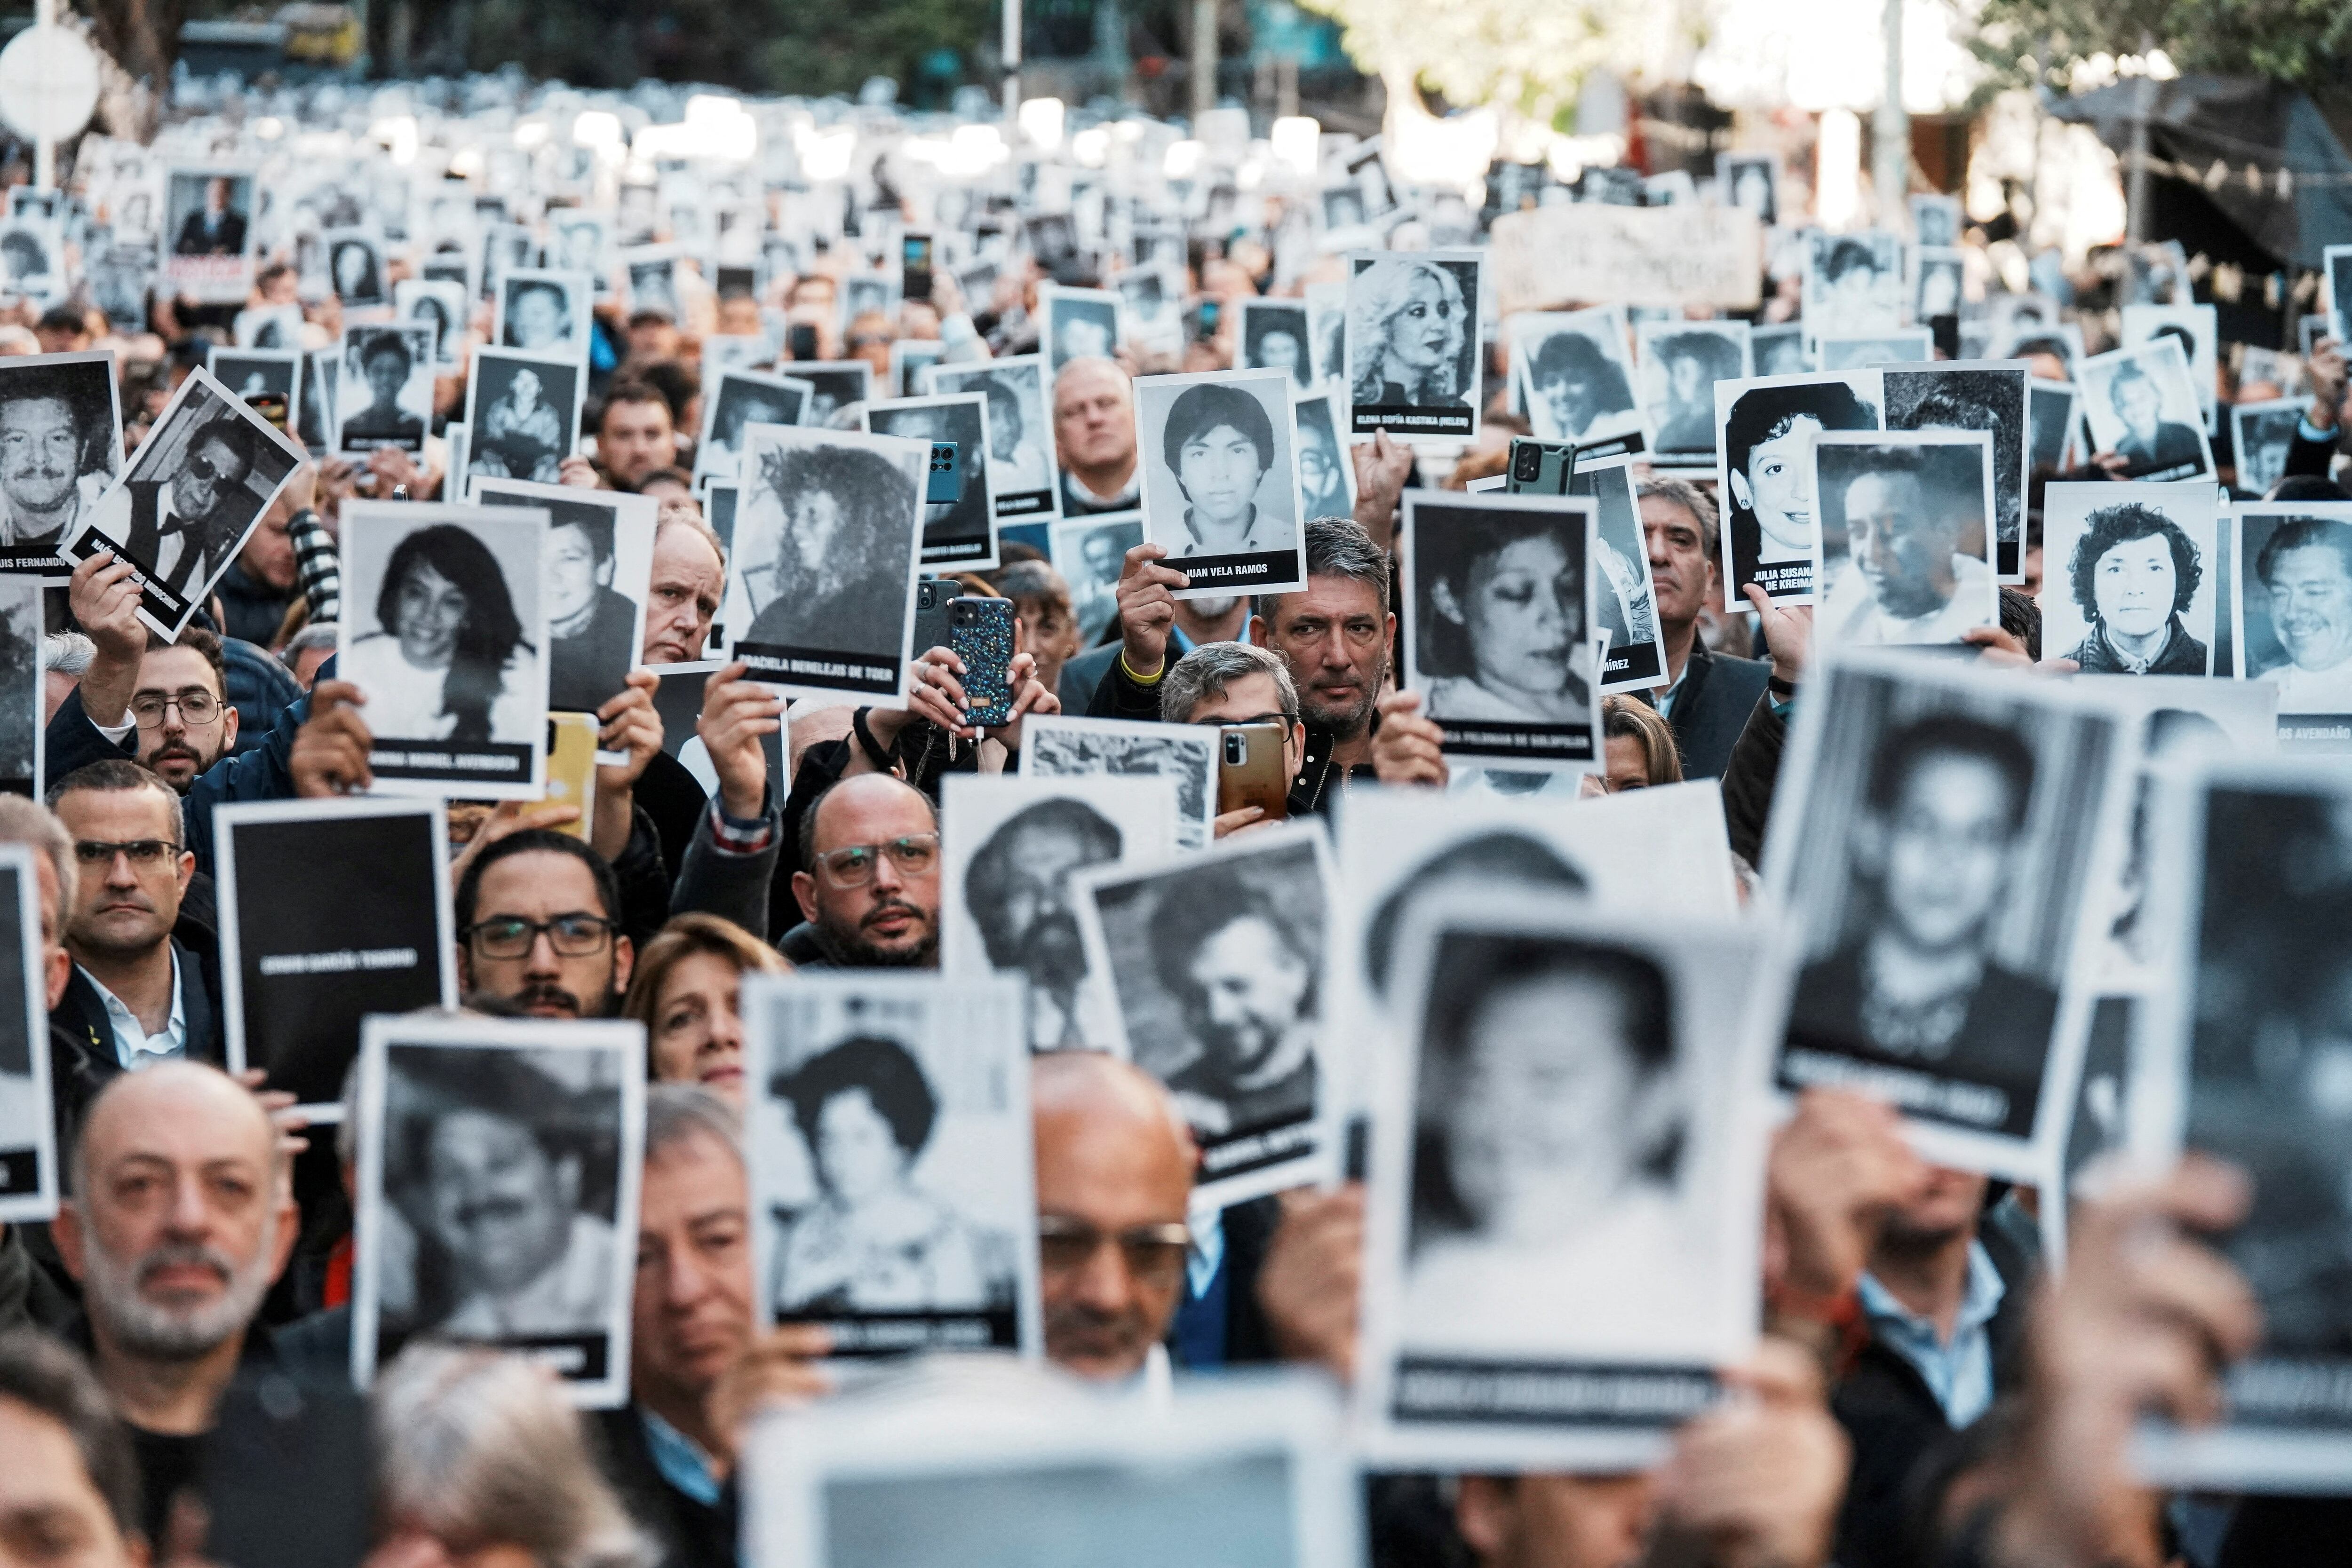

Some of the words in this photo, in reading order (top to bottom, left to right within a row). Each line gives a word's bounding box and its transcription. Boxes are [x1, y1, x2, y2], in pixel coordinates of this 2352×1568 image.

[16, 557, 65, 567] FERNANDO
[1186, 568, 1208, 578] JUAN
[1210, 566, 1233, 576] VELA
[1235, 564, 1268, 574] RAMOS
[1754, 570, 1779, 581] JULIA
[1765, 580, 1778, 591] DE
